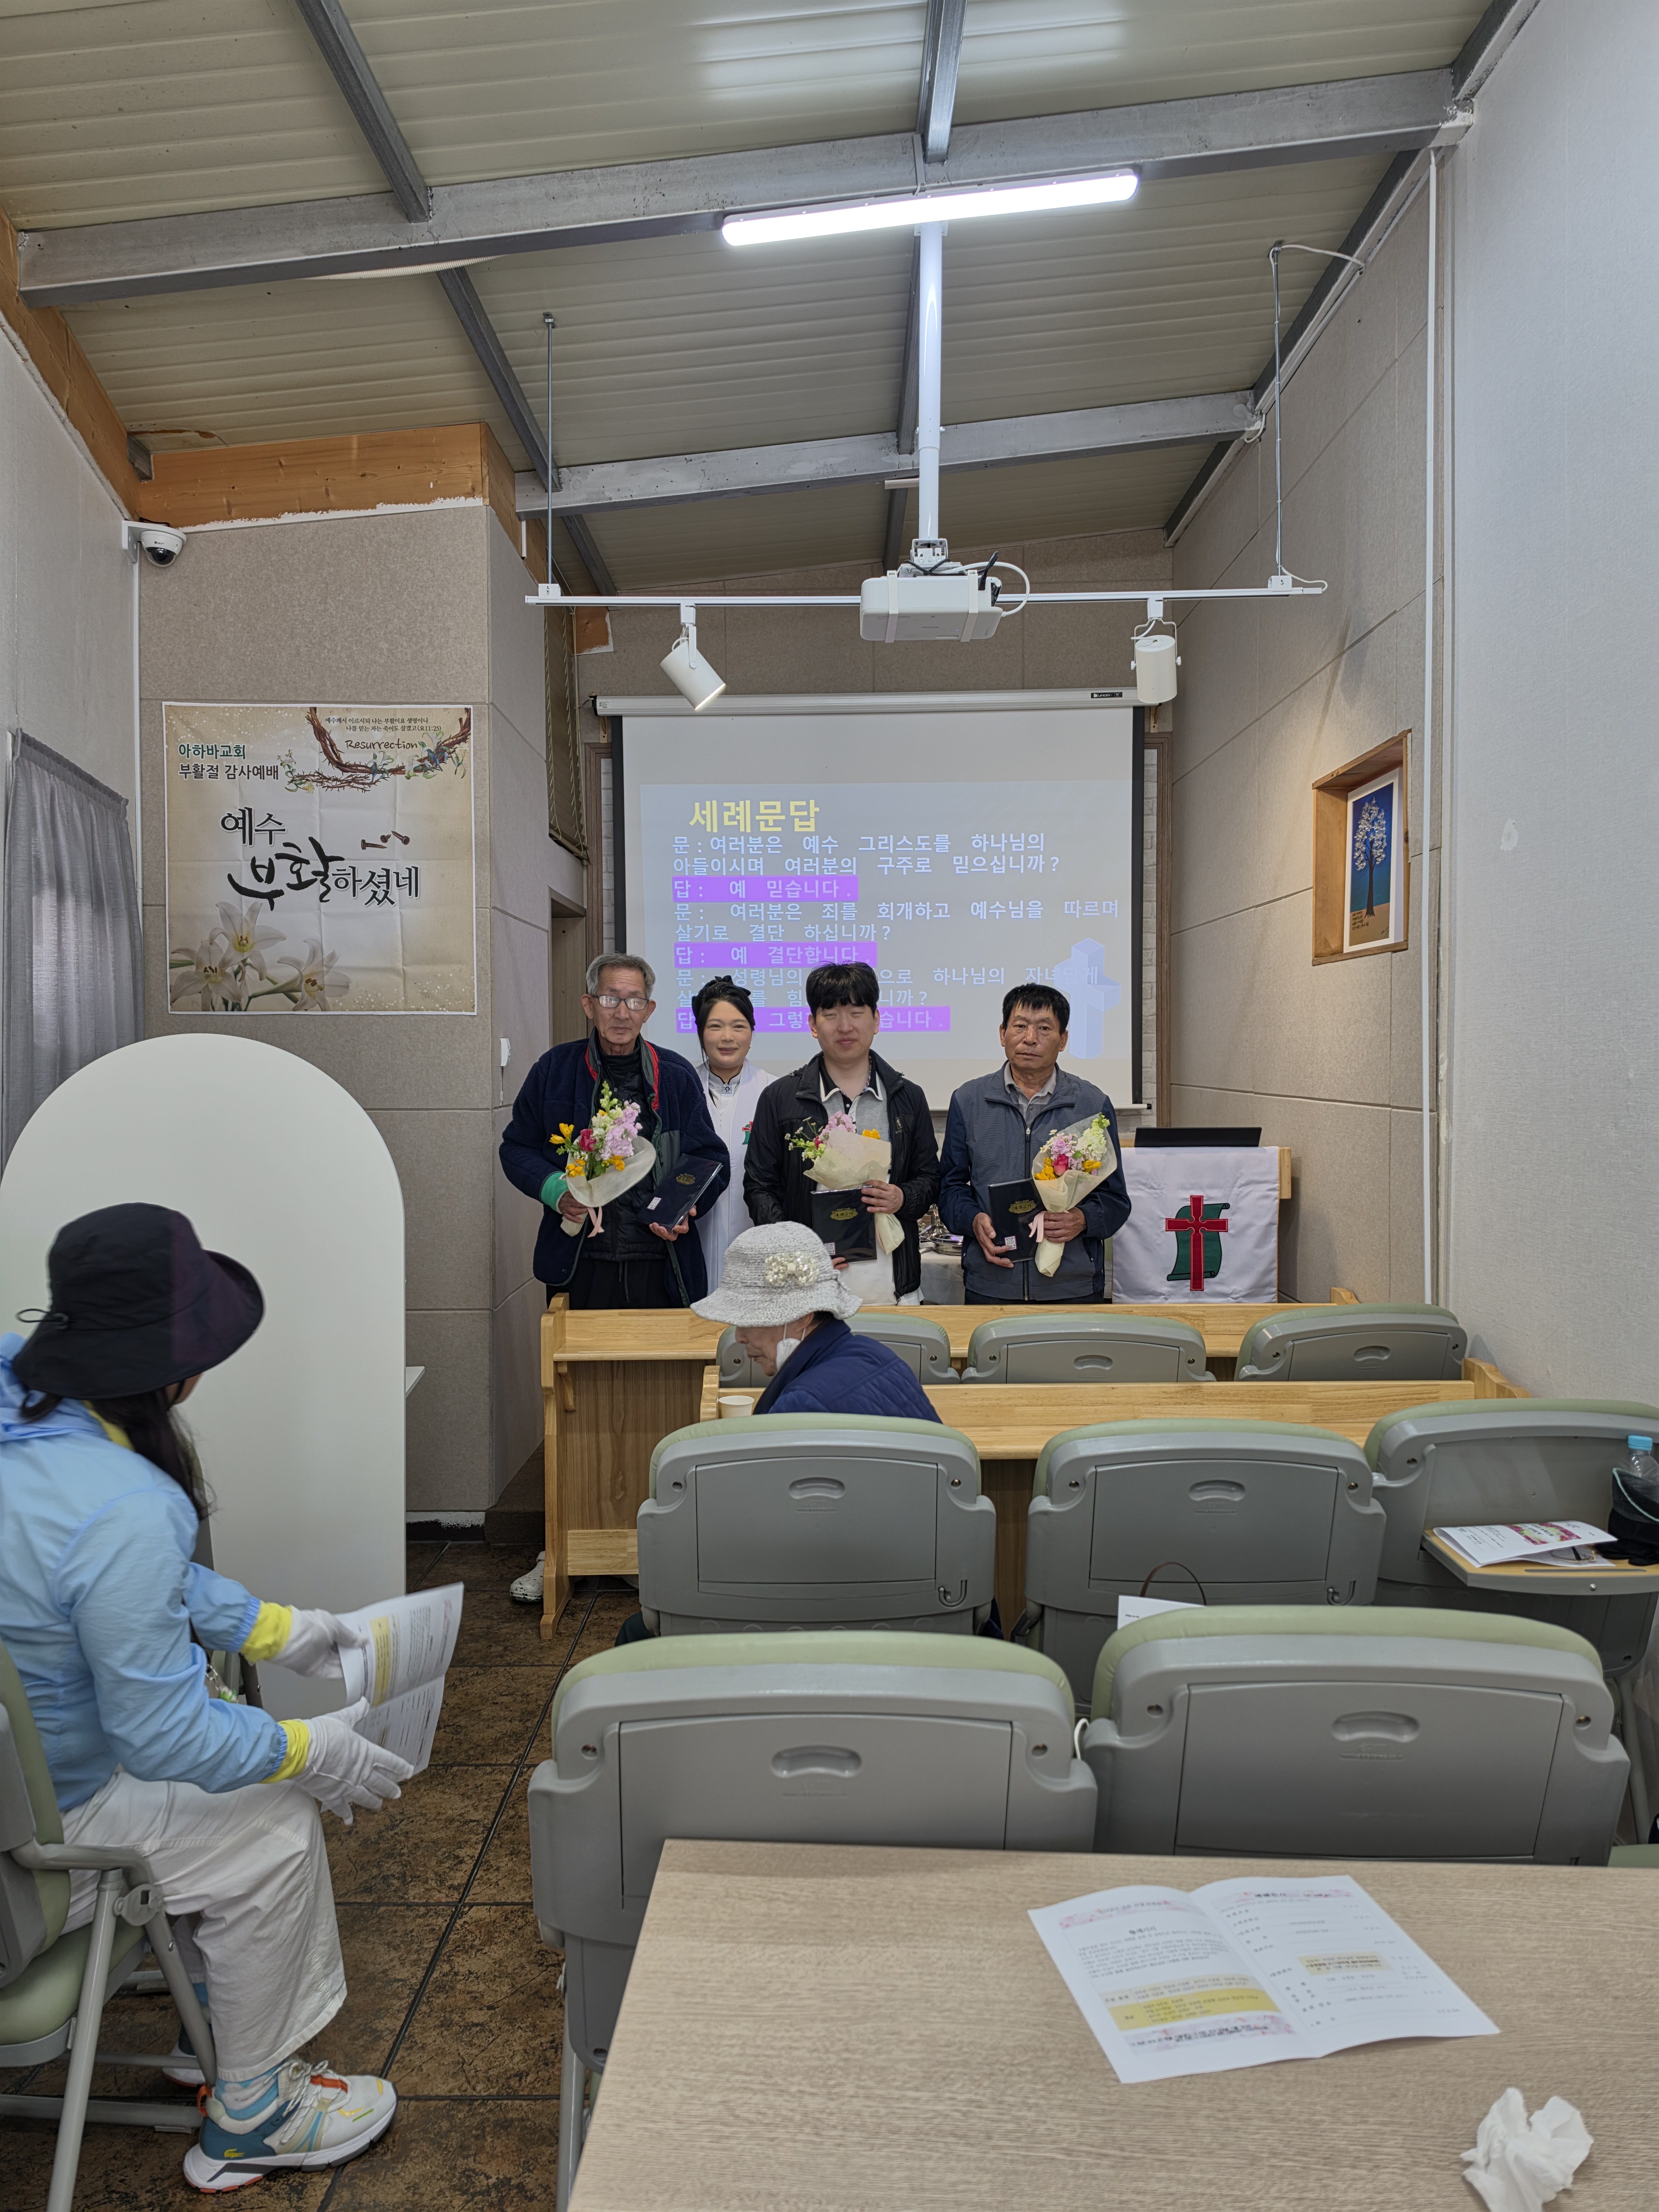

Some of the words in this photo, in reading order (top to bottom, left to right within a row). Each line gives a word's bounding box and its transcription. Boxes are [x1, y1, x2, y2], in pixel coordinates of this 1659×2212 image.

[179, 744, 245, 759] 아하바교회
[345, 738, 417, 750] Resurrection
[179, 764, 218, 779] 부활절
[225, 764, 278, 780] 감사예배
[689, 800, 819, 832] 세례문답
[221, 807, 285, 845] 예수
[803, 836, 838, 854] 예수
[859, 834, 950, 853] 그리스도를
[971, 833, 1044, 852] 하나님의
[227, 837, 420, 911] 부활하셨네
[673, 858, 764, 876] 아들이시며
[785, 857, 856, 875] 여러분의
[878, 857, 932, 875] 구주로
[730, 880, 745, 898] 예
[730, 903, 802, 921] 여러분은
[822, 903, 857, 921] 죄를
[878, 902, 950, 920] 회개하고
[970, 900, 1043, 919] 예수님을
[1064, 900, 1118, 918] 따르며
[675, 925, 729, 942] 살기로
[749, 924, 784, 942] 결단
[731, 946, 747, 964] 예
[732, 969, 802, 987] 성령님의
[933, 967, 1005, 985] 하나님의
